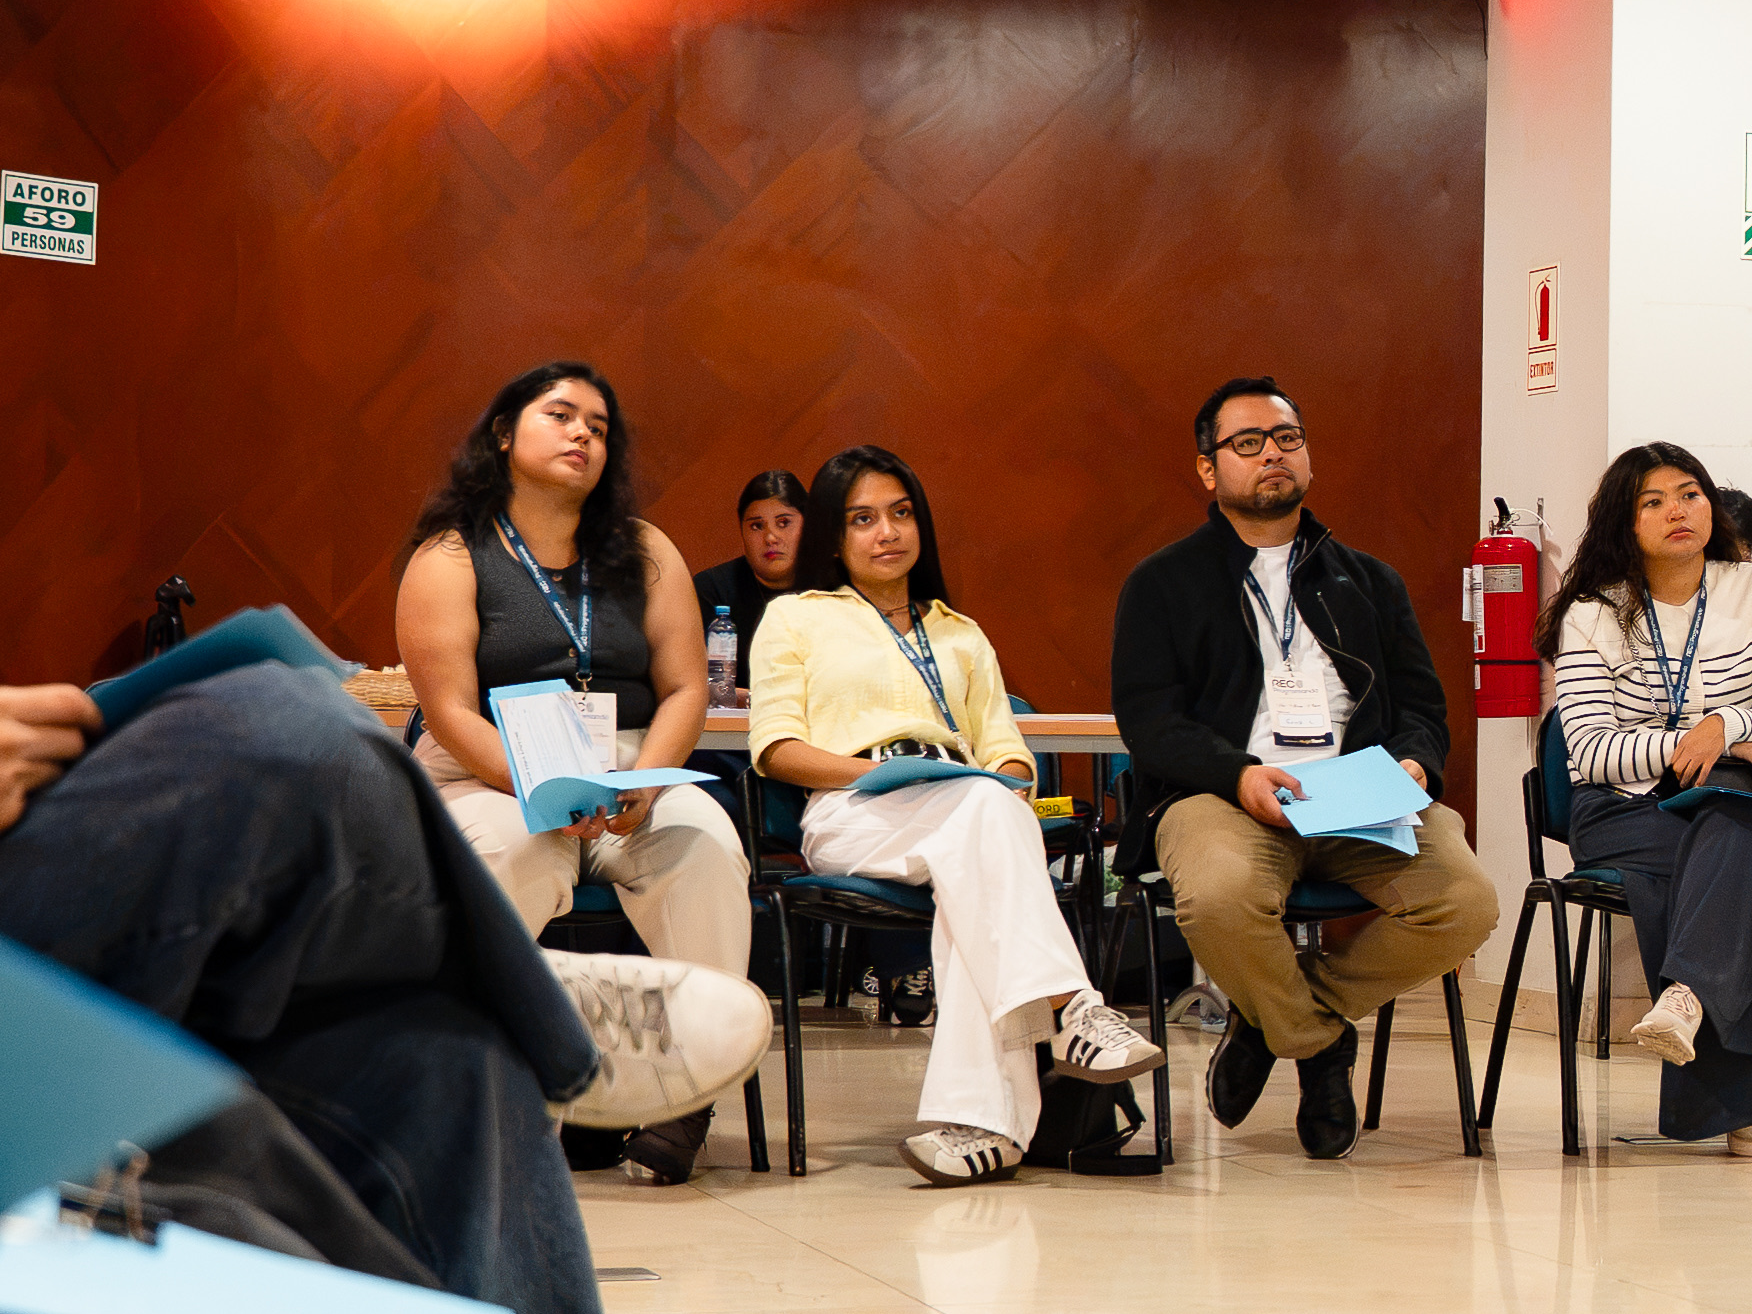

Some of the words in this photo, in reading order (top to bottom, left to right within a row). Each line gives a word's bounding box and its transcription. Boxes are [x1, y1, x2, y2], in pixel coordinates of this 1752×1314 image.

[13, 183, 86, 207] AFORO
[23, 207, 76, 229] 59
[12, 231, 84, 254] PERSONAS
[1530, 361, 1554, 378] EXTINTOR
